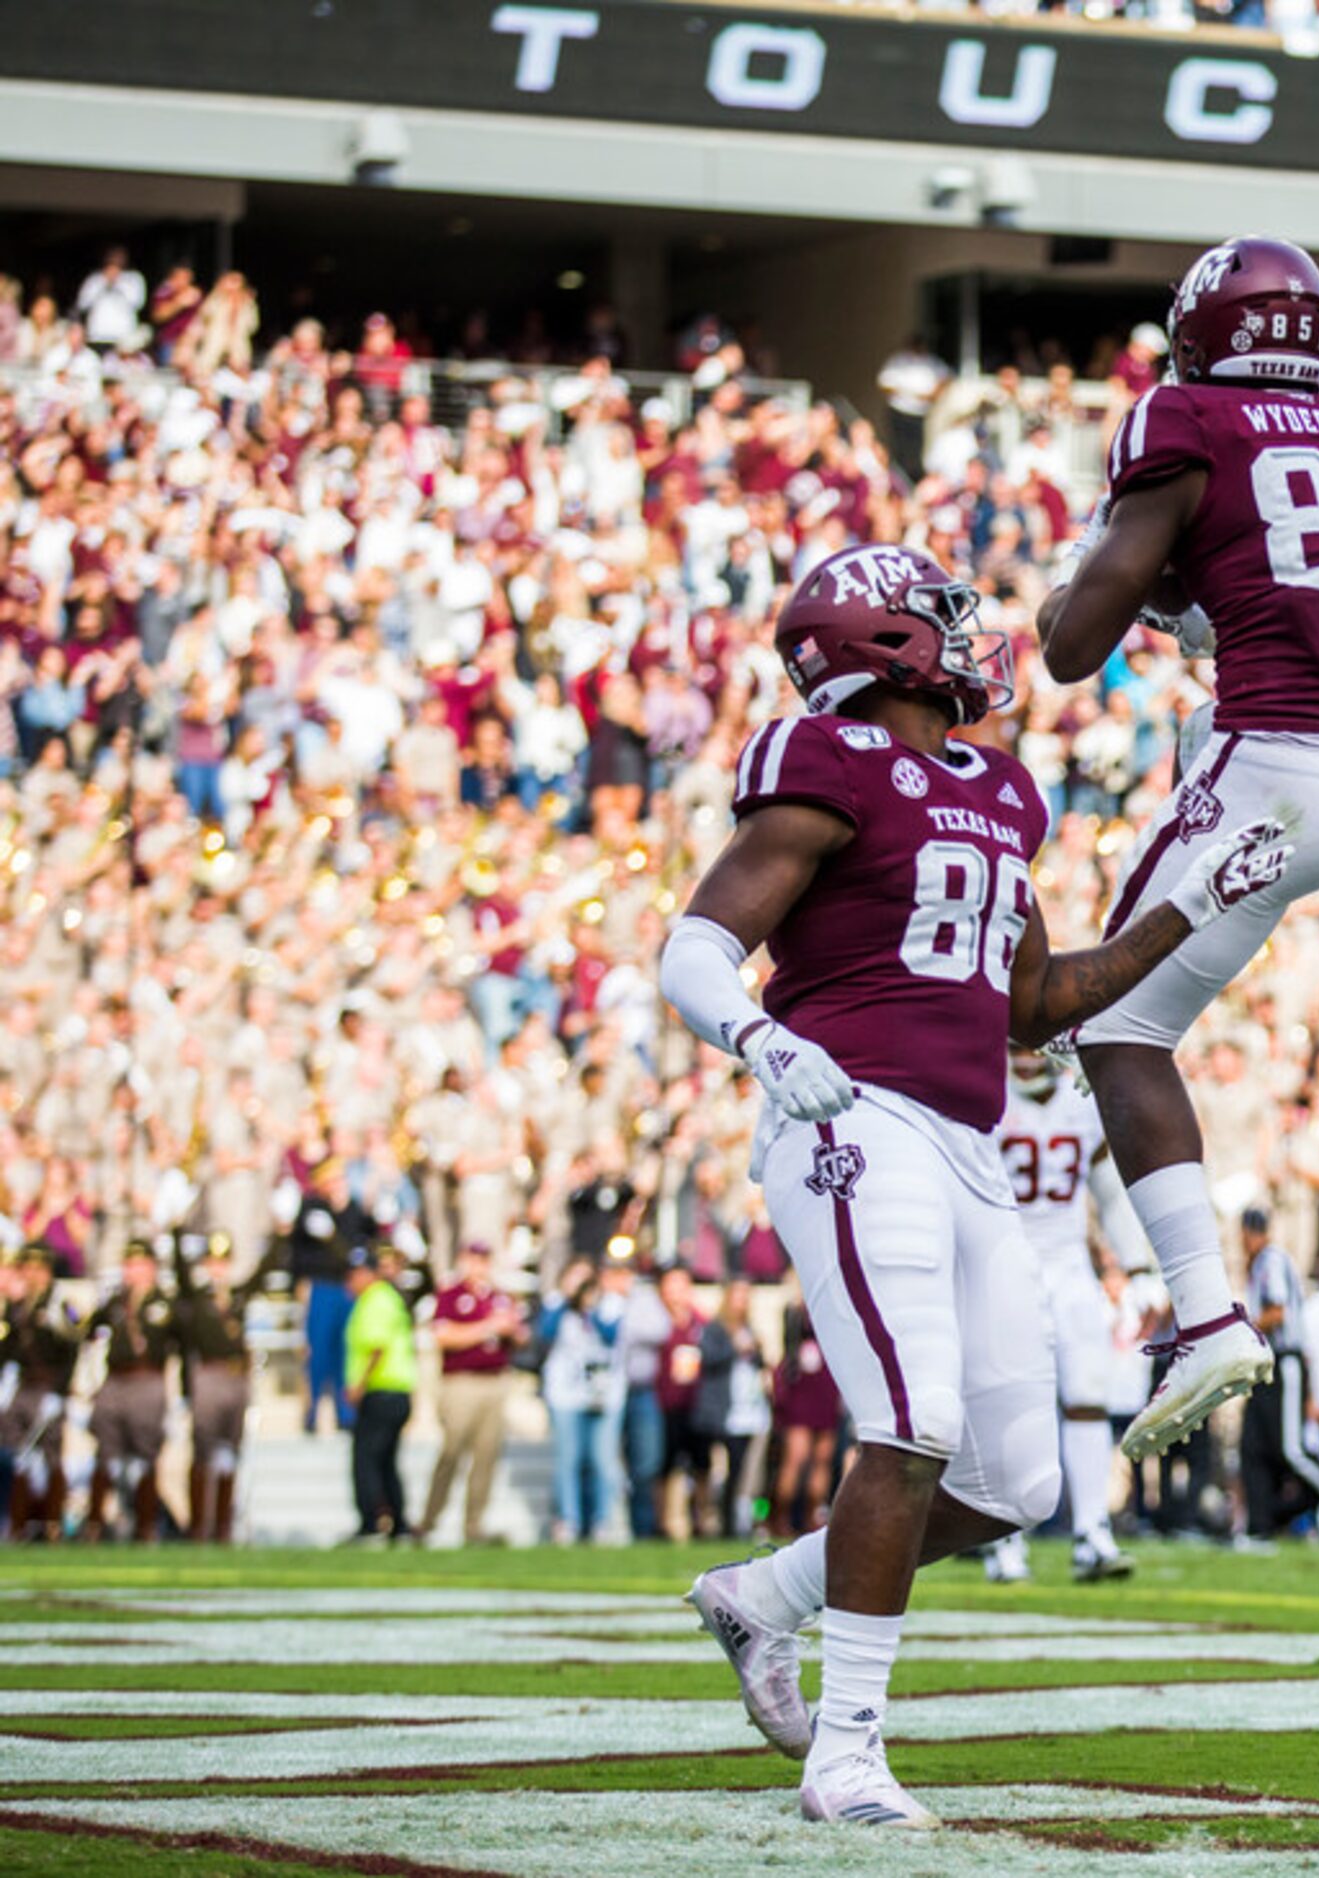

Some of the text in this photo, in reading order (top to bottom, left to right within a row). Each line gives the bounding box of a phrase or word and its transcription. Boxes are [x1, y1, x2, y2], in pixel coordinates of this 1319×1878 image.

[1250, 361, 1295, 375] TEXAS
[926, 806, 990, 838] TEXAS
[899, 839, 1034, 997] 86
[1001, 1136, 1081, 1204] 33
